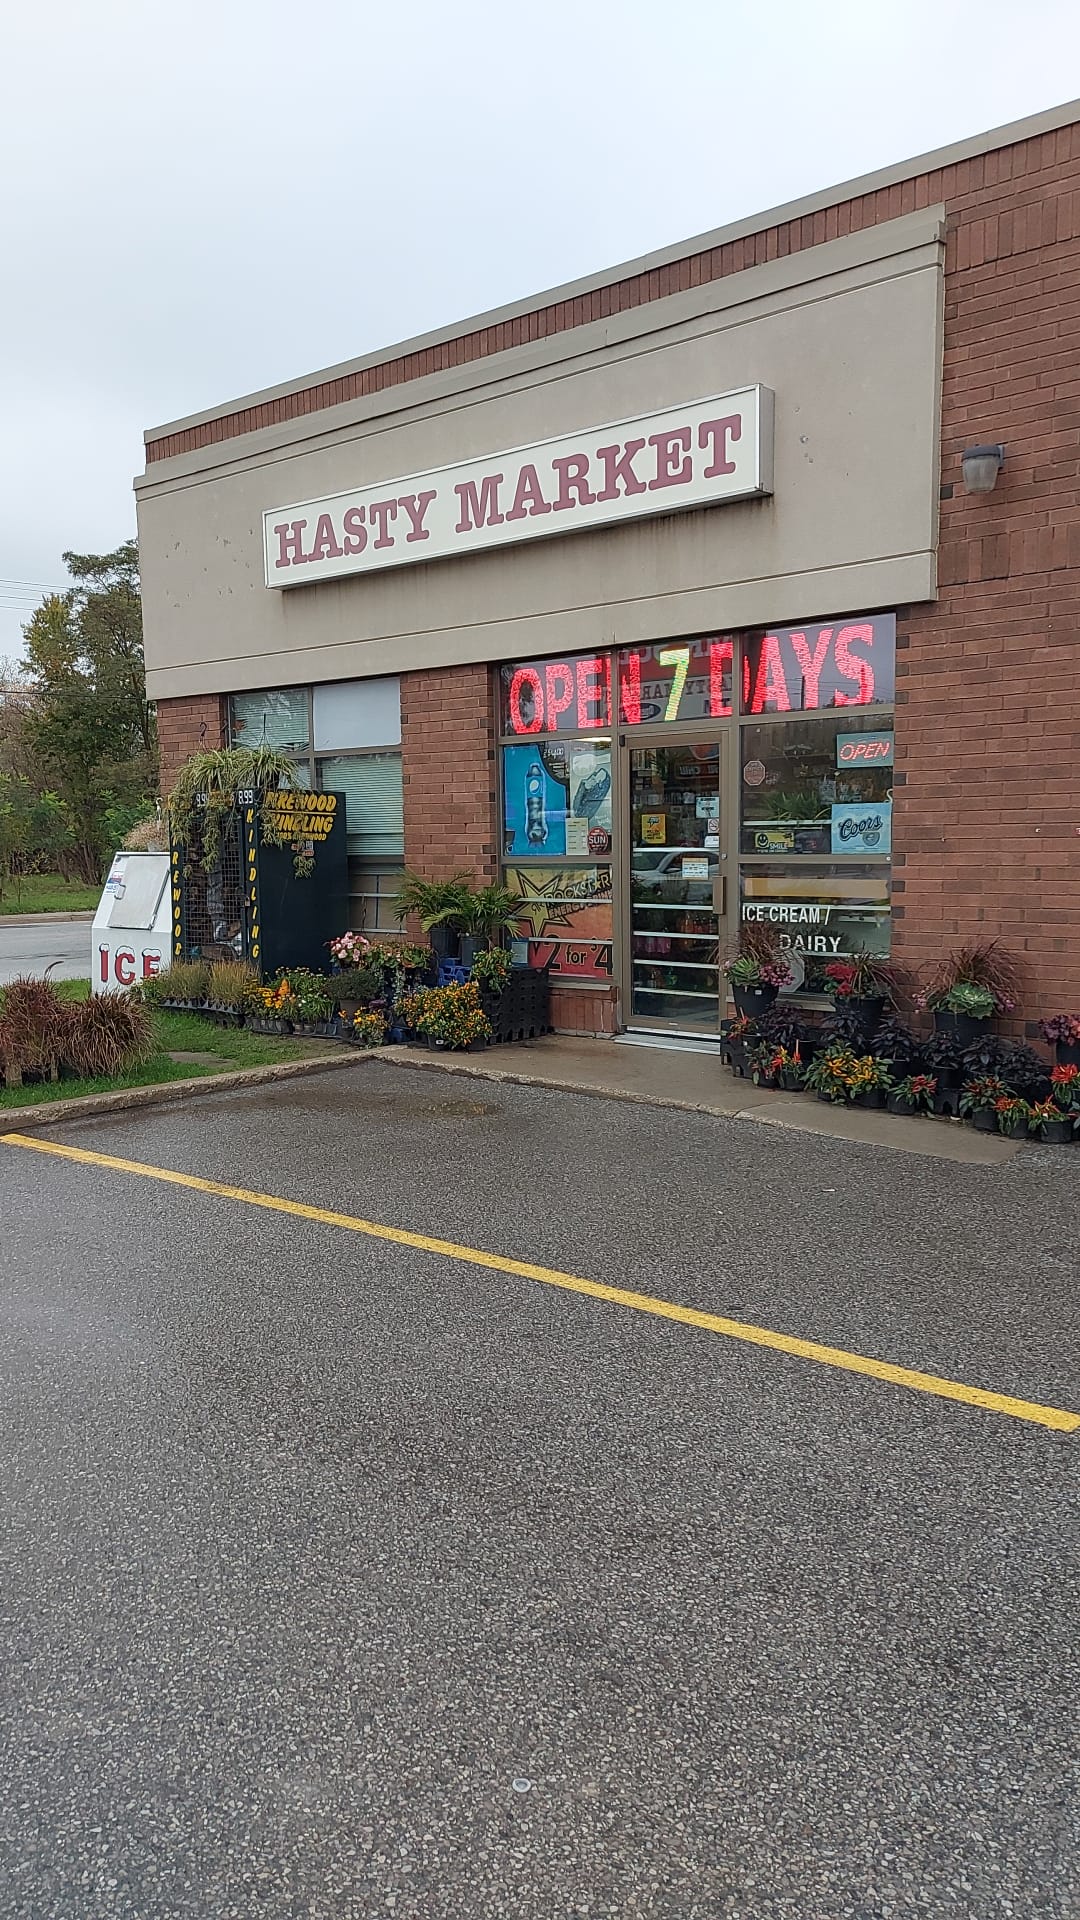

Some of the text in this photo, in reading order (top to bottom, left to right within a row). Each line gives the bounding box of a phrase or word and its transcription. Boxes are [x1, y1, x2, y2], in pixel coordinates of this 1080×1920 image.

[274, 414, 743, 568] HASTY MARKET
[510, 624, 875, 734] OPEN 7 DAYS
[839, 741, 890, 761] OPEN
[588, 836, 606, 845] SUN
[839, 815, 884, 842] Coors
[171, 833, 183, 956] IREWOOD
[742, 905, 765, 921] ICE
[769, 906, 820, 923] CREAM
[543, 933, 562, 971] 2
[565, 945, 588, 965] for
[779, 934, 842, 953] DAIRY
[98, 943, 162, 986] ICE
